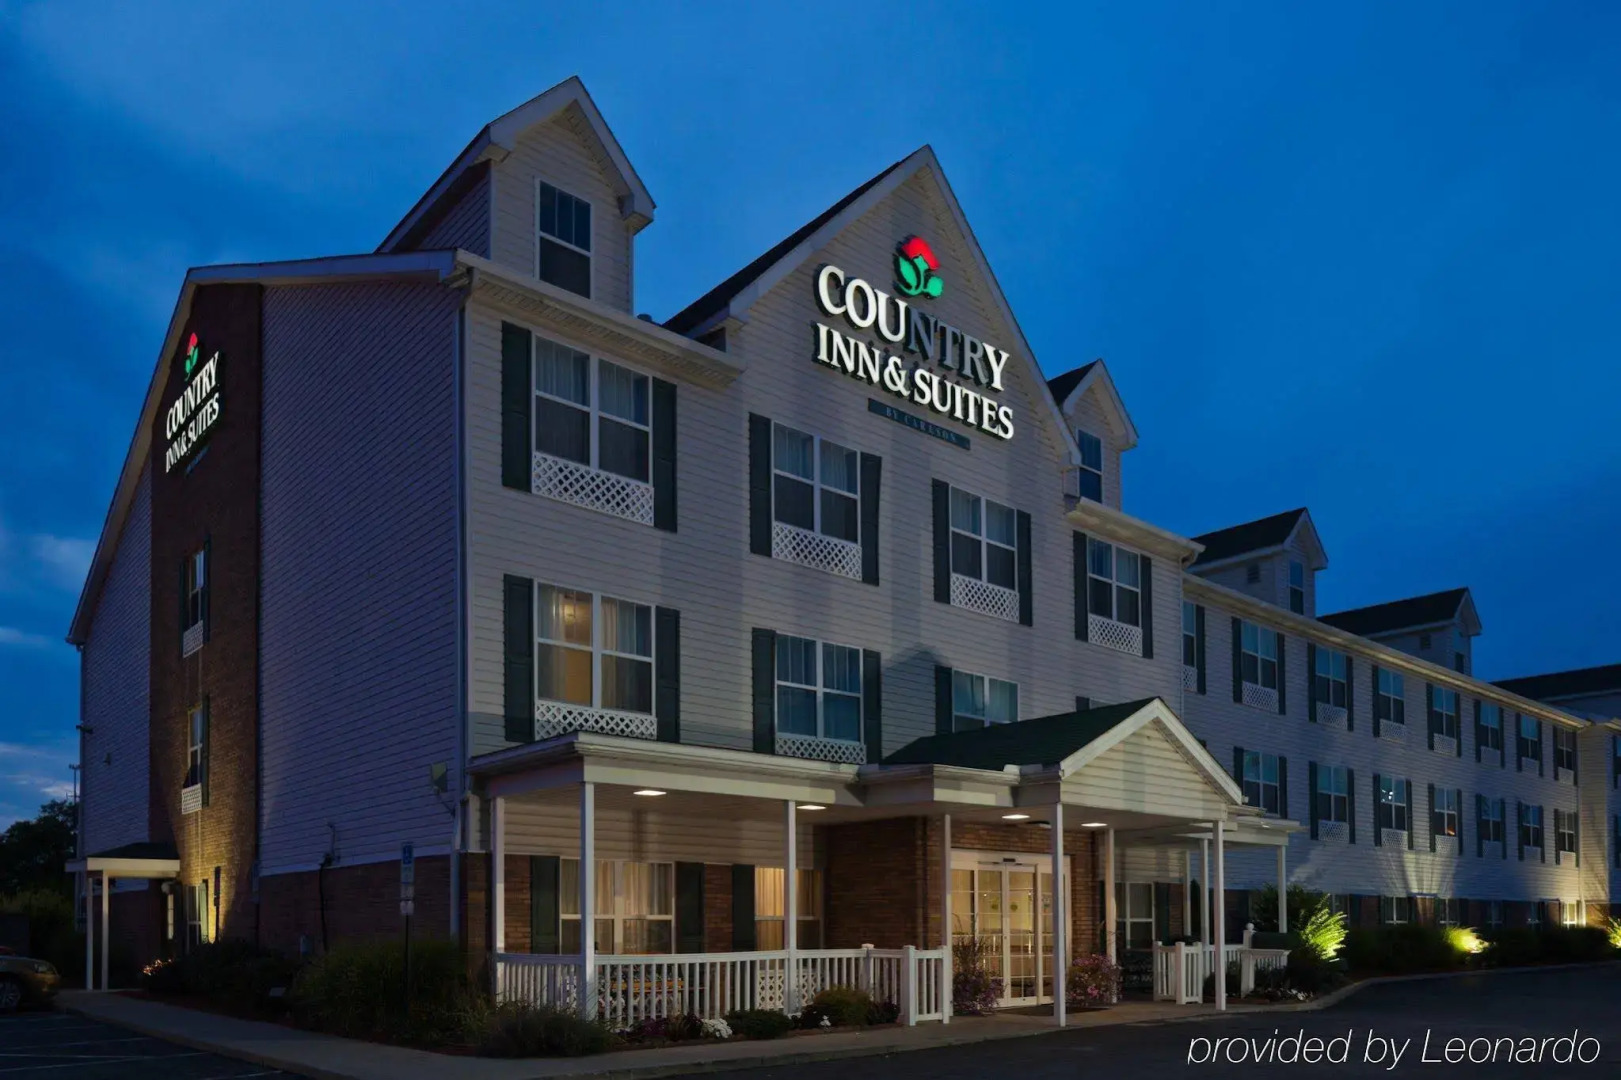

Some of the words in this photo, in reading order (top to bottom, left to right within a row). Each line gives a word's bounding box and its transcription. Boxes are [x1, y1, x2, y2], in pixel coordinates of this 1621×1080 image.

[817, 265, 1010, 391] COUNTRY
[166, 351, 219, 440] COUNTRY
[188, 392, 219, 448] SUITES
[914, 368, 1014, 439] SUITES
